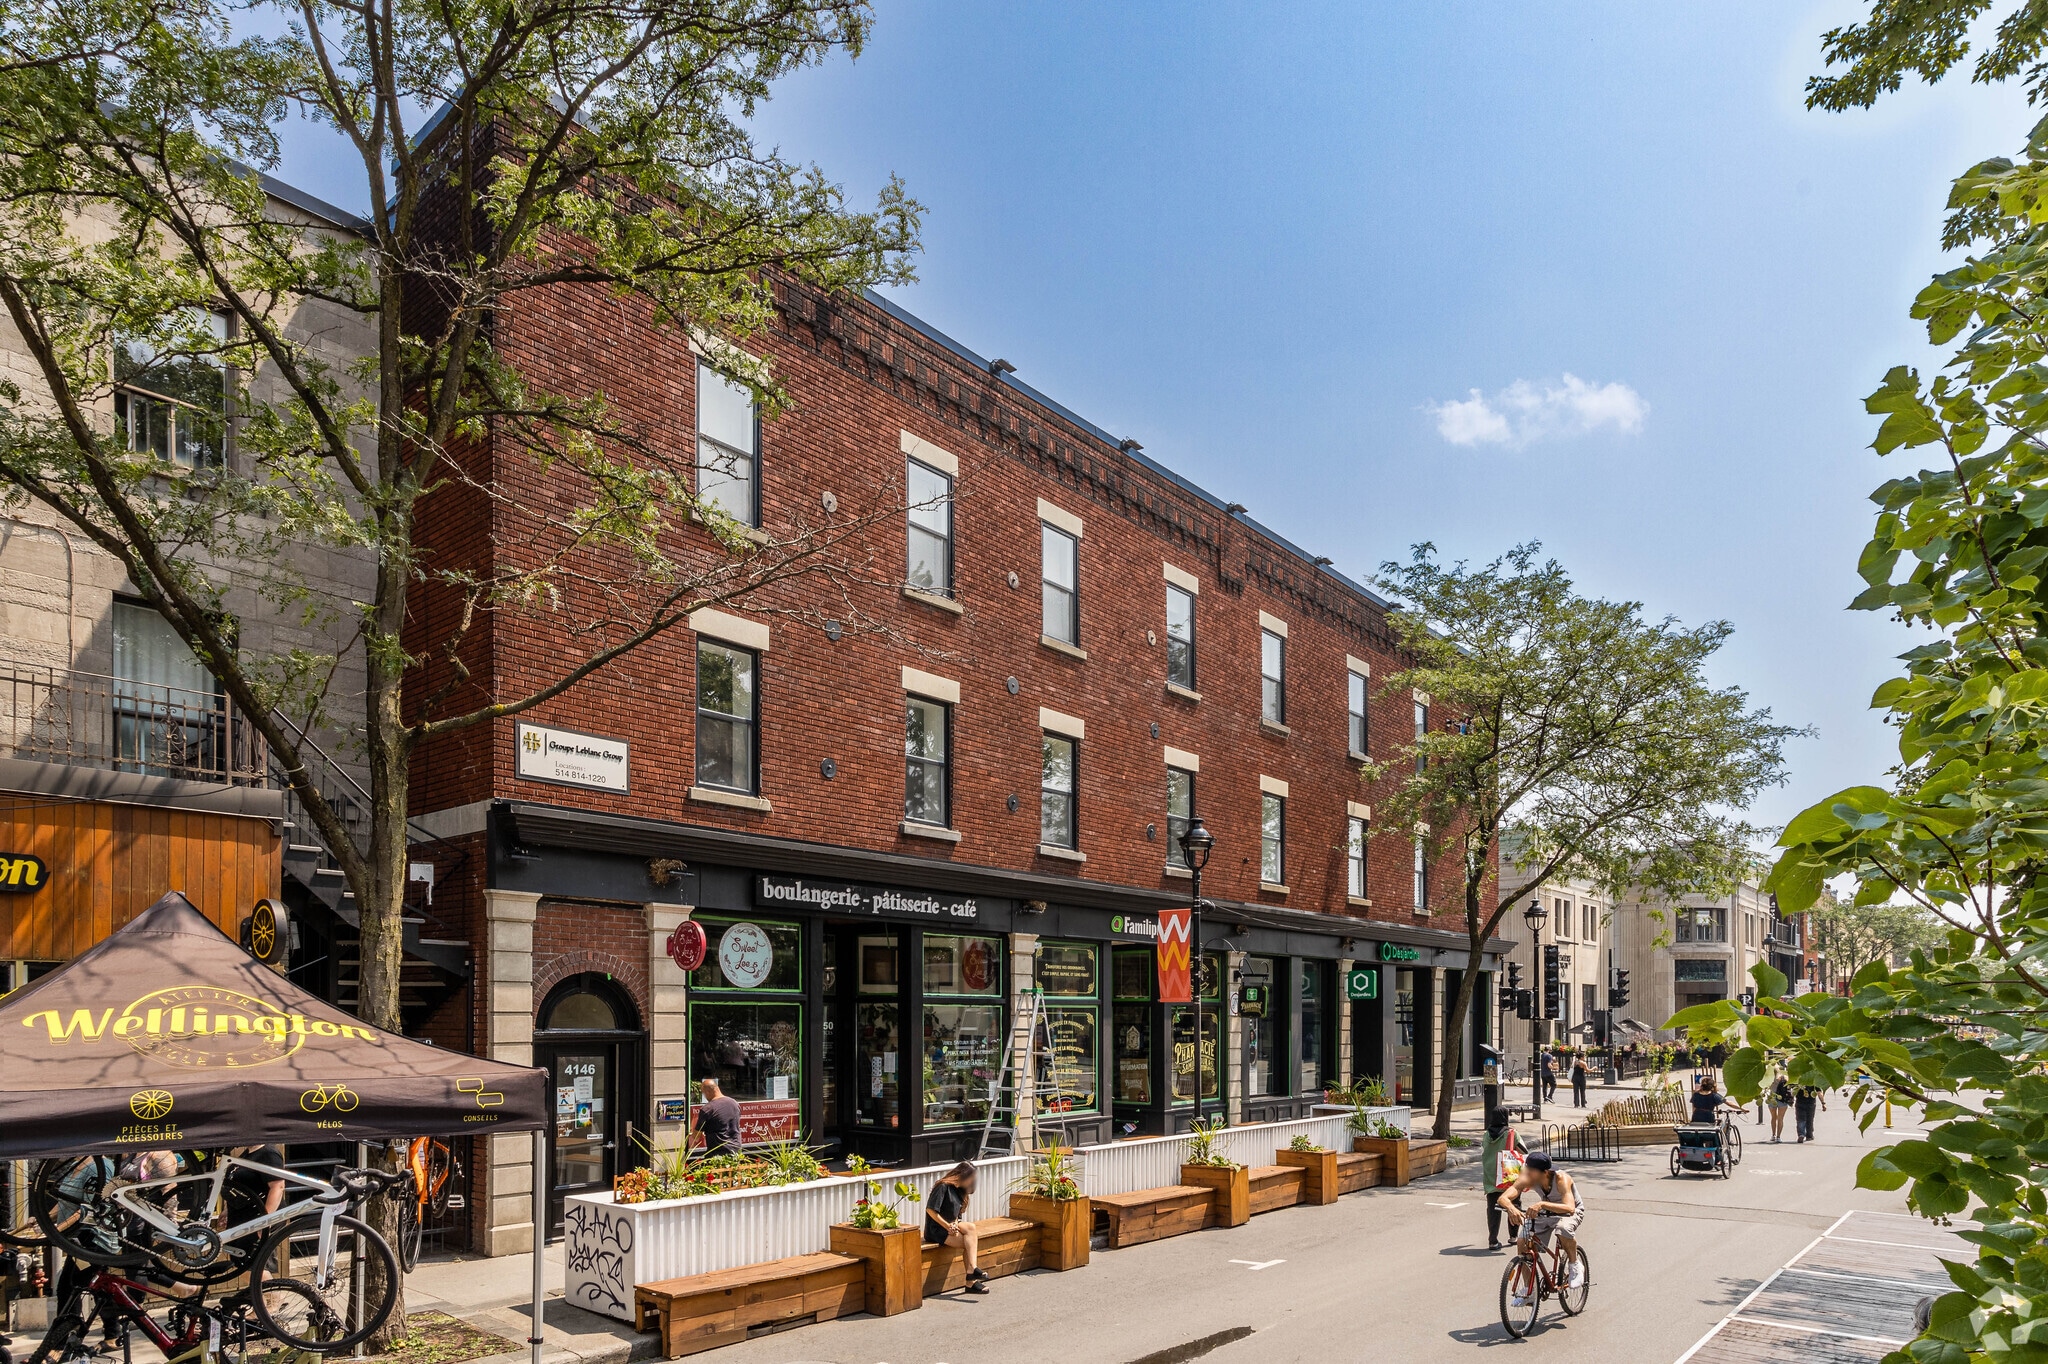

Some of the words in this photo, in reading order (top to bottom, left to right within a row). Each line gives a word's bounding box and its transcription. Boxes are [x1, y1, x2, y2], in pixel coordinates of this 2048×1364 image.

[549, 741, 574, 754] Groupe
[575, 745, 602, 757] Leblanc
[602, 750, 624, 762] Group
[555, 769, 570, 778] 514
[571, 771, 606, 783] 814-1220
[762, 877, 861, 910] boulangerie
[872, 891, 940, 914] pâtisserie
[950, 900, 977, 918] café
[1124, 916, 1159, 939] Familip
[731, 936, 765, 953] Sweet
[1392, 946, 1420, 961] Desjardins
[158, 990, 252, 1006] ATELIER
[22, 1007, 377, 1043] Wellington
[1174, 1040, 1215, 1065] PHARACIE
[564, 1064, 596, 1075] 4146
[317, 1119, 343, 1129] VÉLOS
[463, 1114, 498, 1122] CONSEILS
[122, 1123, 159, 1134] PIÈCES
[165, 1123, 178, 1132] ET
[115, 1131, 183, 1143] ACCESSOIRES
